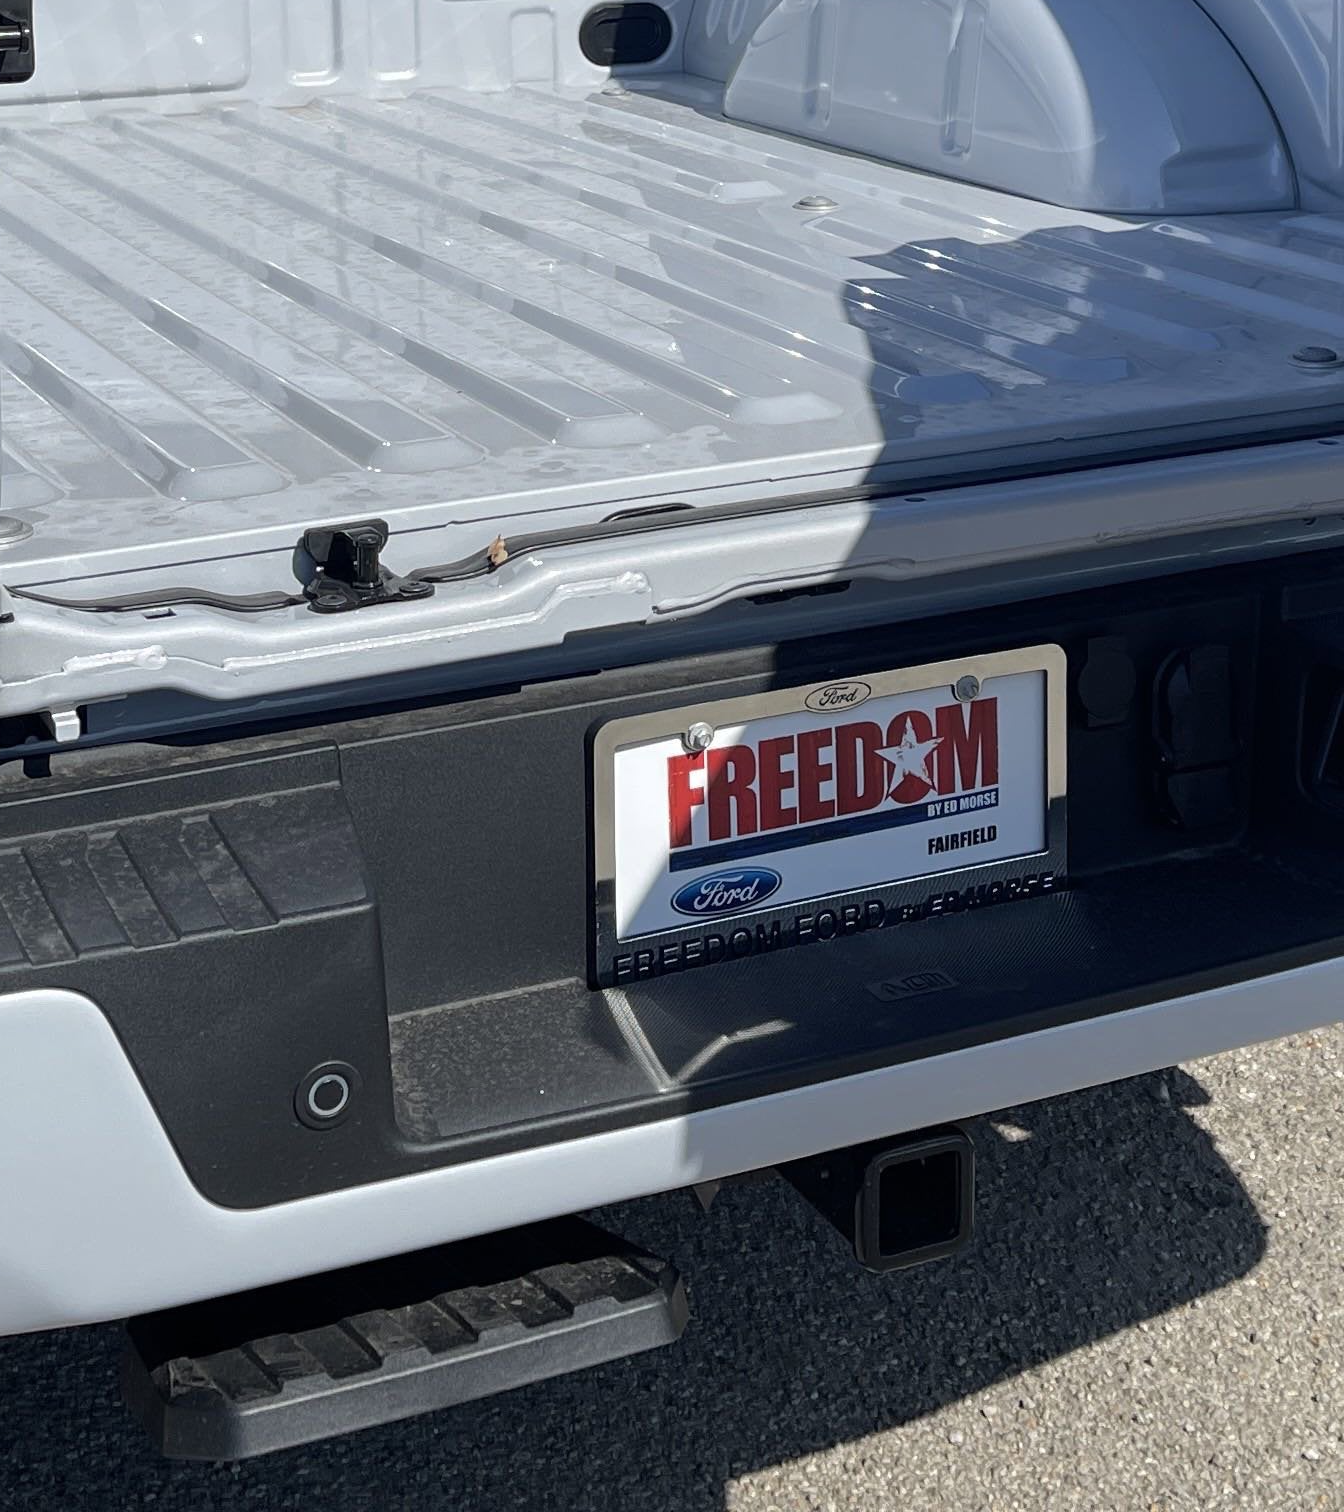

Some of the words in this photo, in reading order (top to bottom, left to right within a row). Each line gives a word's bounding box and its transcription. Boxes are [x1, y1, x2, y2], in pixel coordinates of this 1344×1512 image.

[818, 684, 859, 707] Ford
[667, 696, 999, 849] FREEDOM
[927, 803, 942, 817] BY
[943, 800, 957, 815] ED
[959, 791, 997, 811] MORSE
[927, 825, 997, 855] FAIRFIELD
[693, 874, 761, 911] Ford
[613, 920, 781, 985] FREEDOM
[794, 899, 885, 946] FORD
